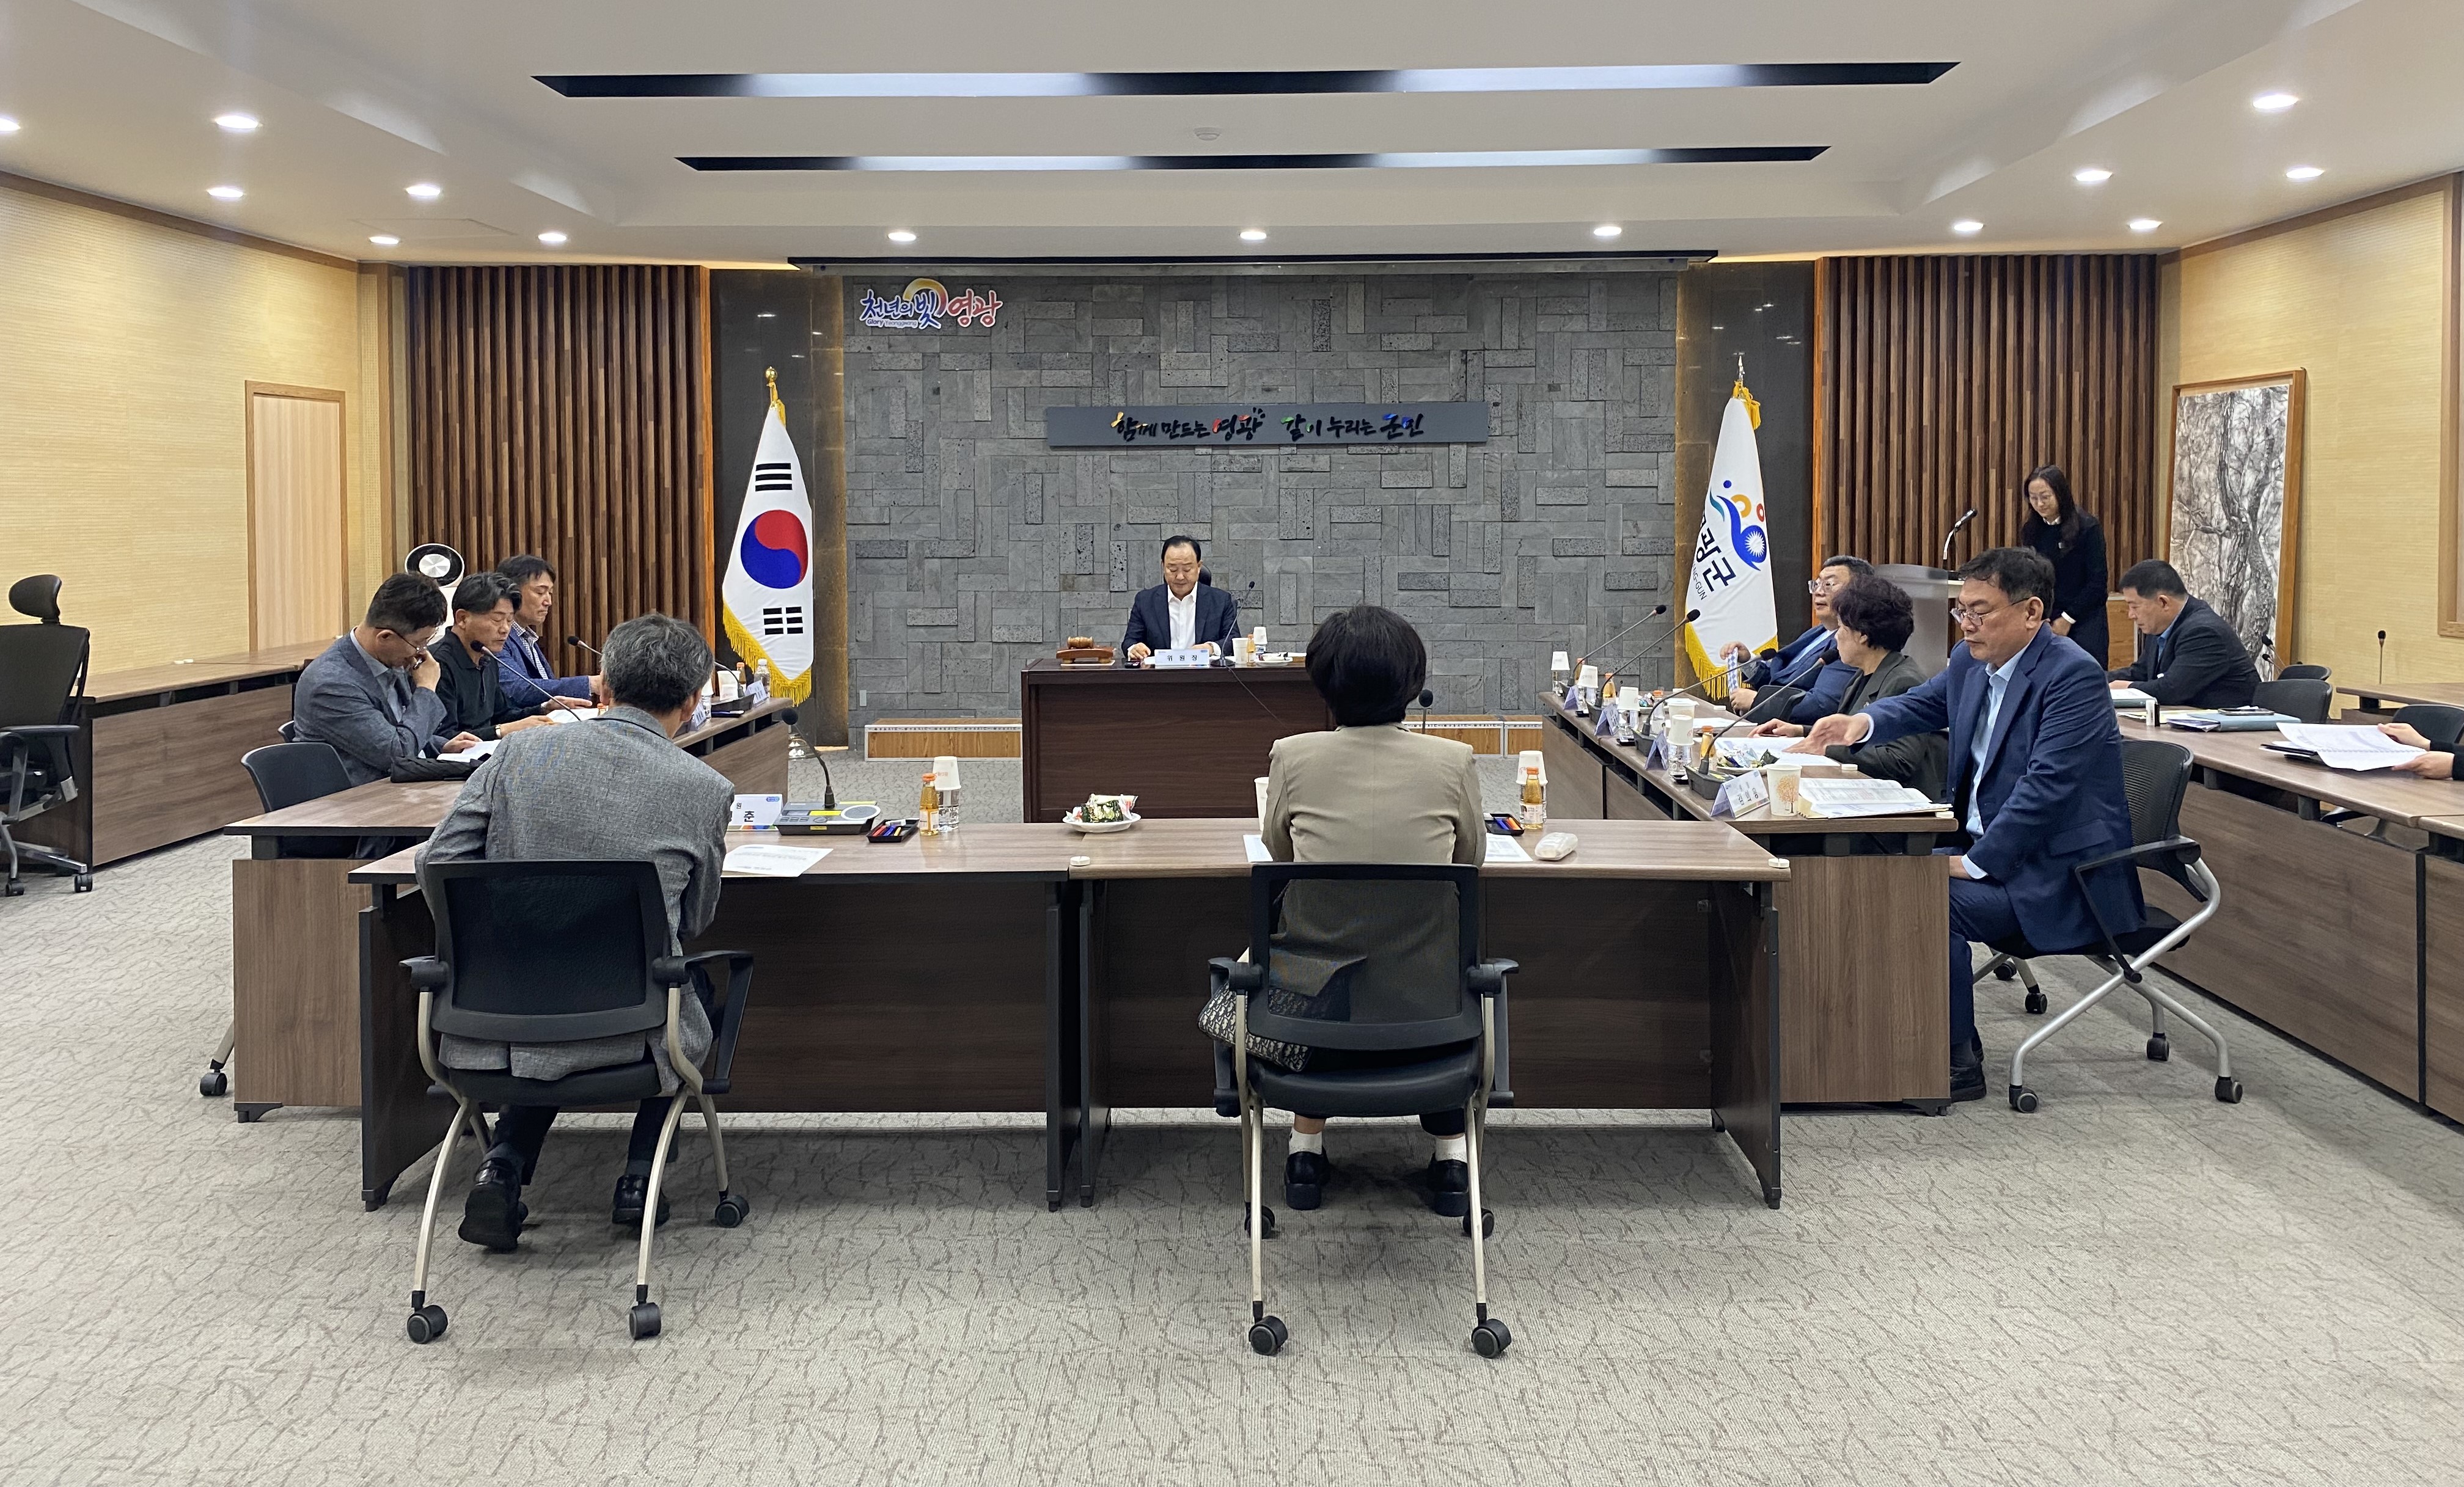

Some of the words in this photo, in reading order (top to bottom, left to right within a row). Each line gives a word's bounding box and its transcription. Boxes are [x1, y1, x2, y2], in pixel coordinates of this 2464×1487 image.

[947, 289, 1003, 326] 영광
[1111, 412, 1157, 441] 함께
[1161, 419, 1211, 439] 만드는
[1212, 412, 1264, 441] 영광
[1280, 414, 1322, 442] 같이
[1327, 416, 1376, 438] 누리는
[1380, 413, 1424, 440] 군민
[743, 810, 755, 822] 춘
